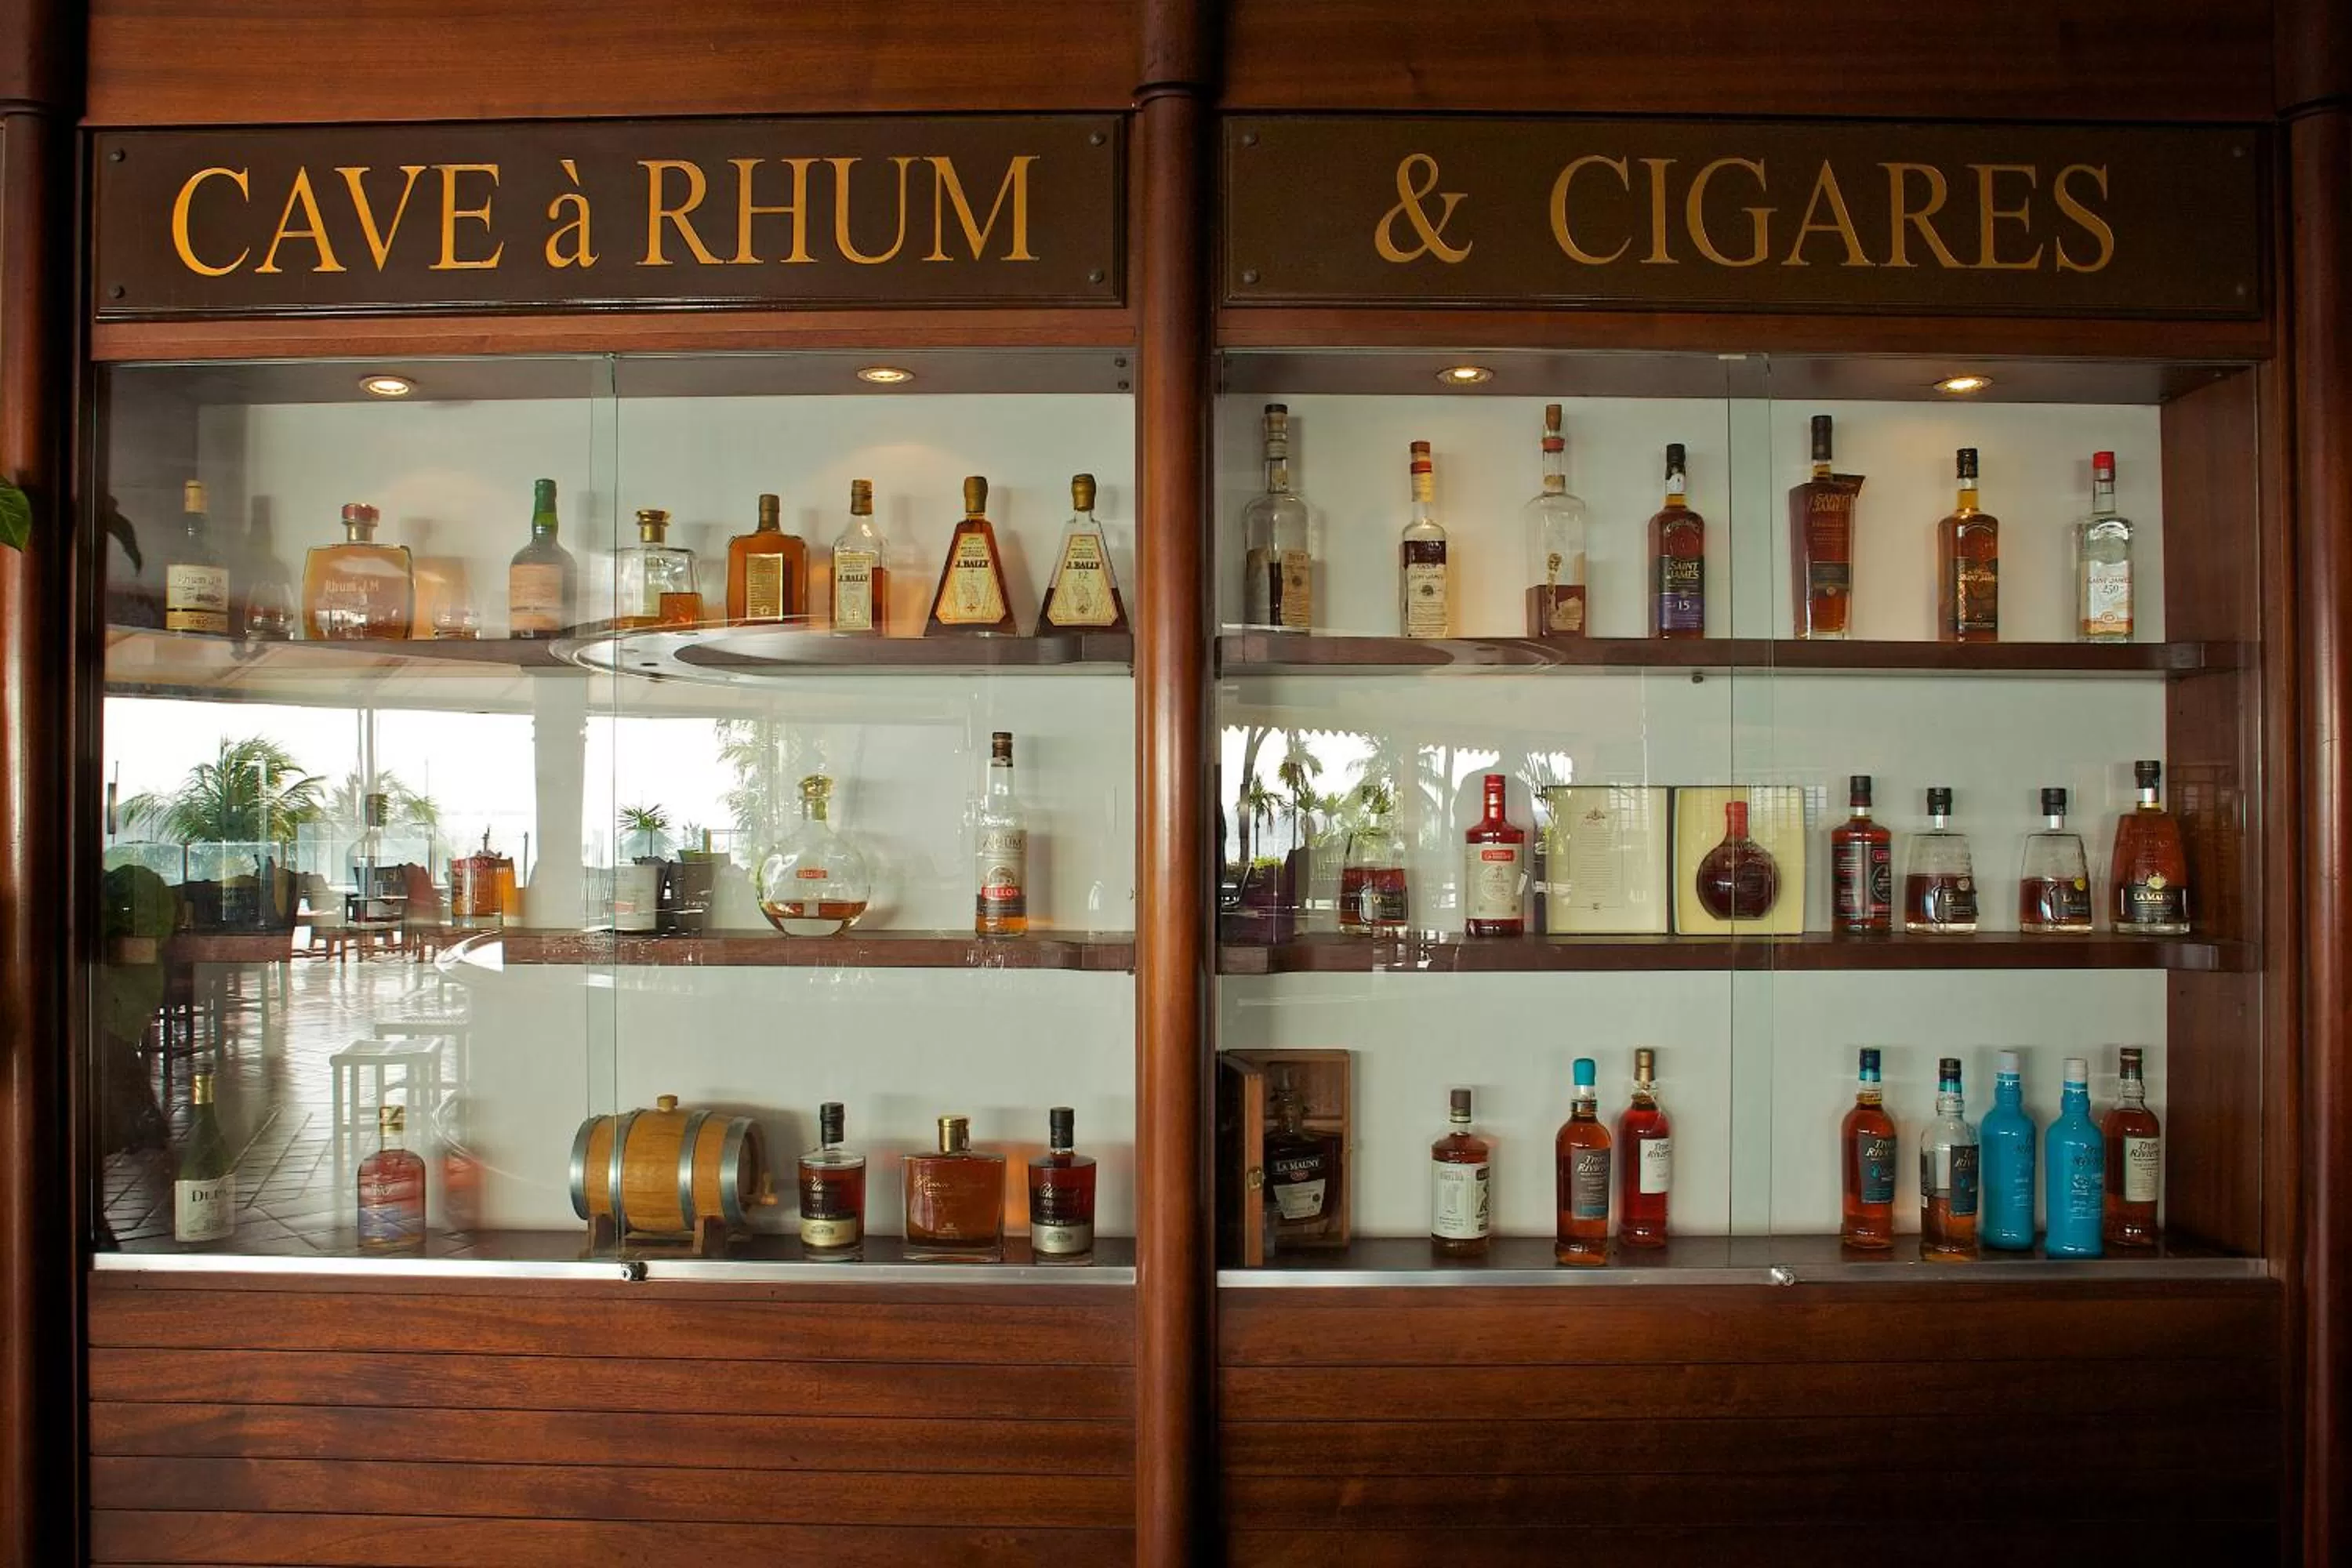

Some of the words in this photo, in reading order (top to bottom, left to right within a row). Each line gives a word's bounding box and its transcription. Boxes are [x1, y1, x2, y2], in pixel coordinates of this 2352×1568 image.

[171, 163, 504, 276] CAVE
[545, 159, 600, 269] à
[635, 155, 1040, 265] RHUM
[1374, 153, 1473, 263] &
[1549, 154, 2115, 274] CIGARES
[1669, 561, 1699, 571] SAINT
[1666, 570, 1700, 579] JAMES
[1678, 600, 1690, 611] 15
[1276, 1161, 1288, 1172] LA
[1289, 1159, 1319, 1171] MAUNY
